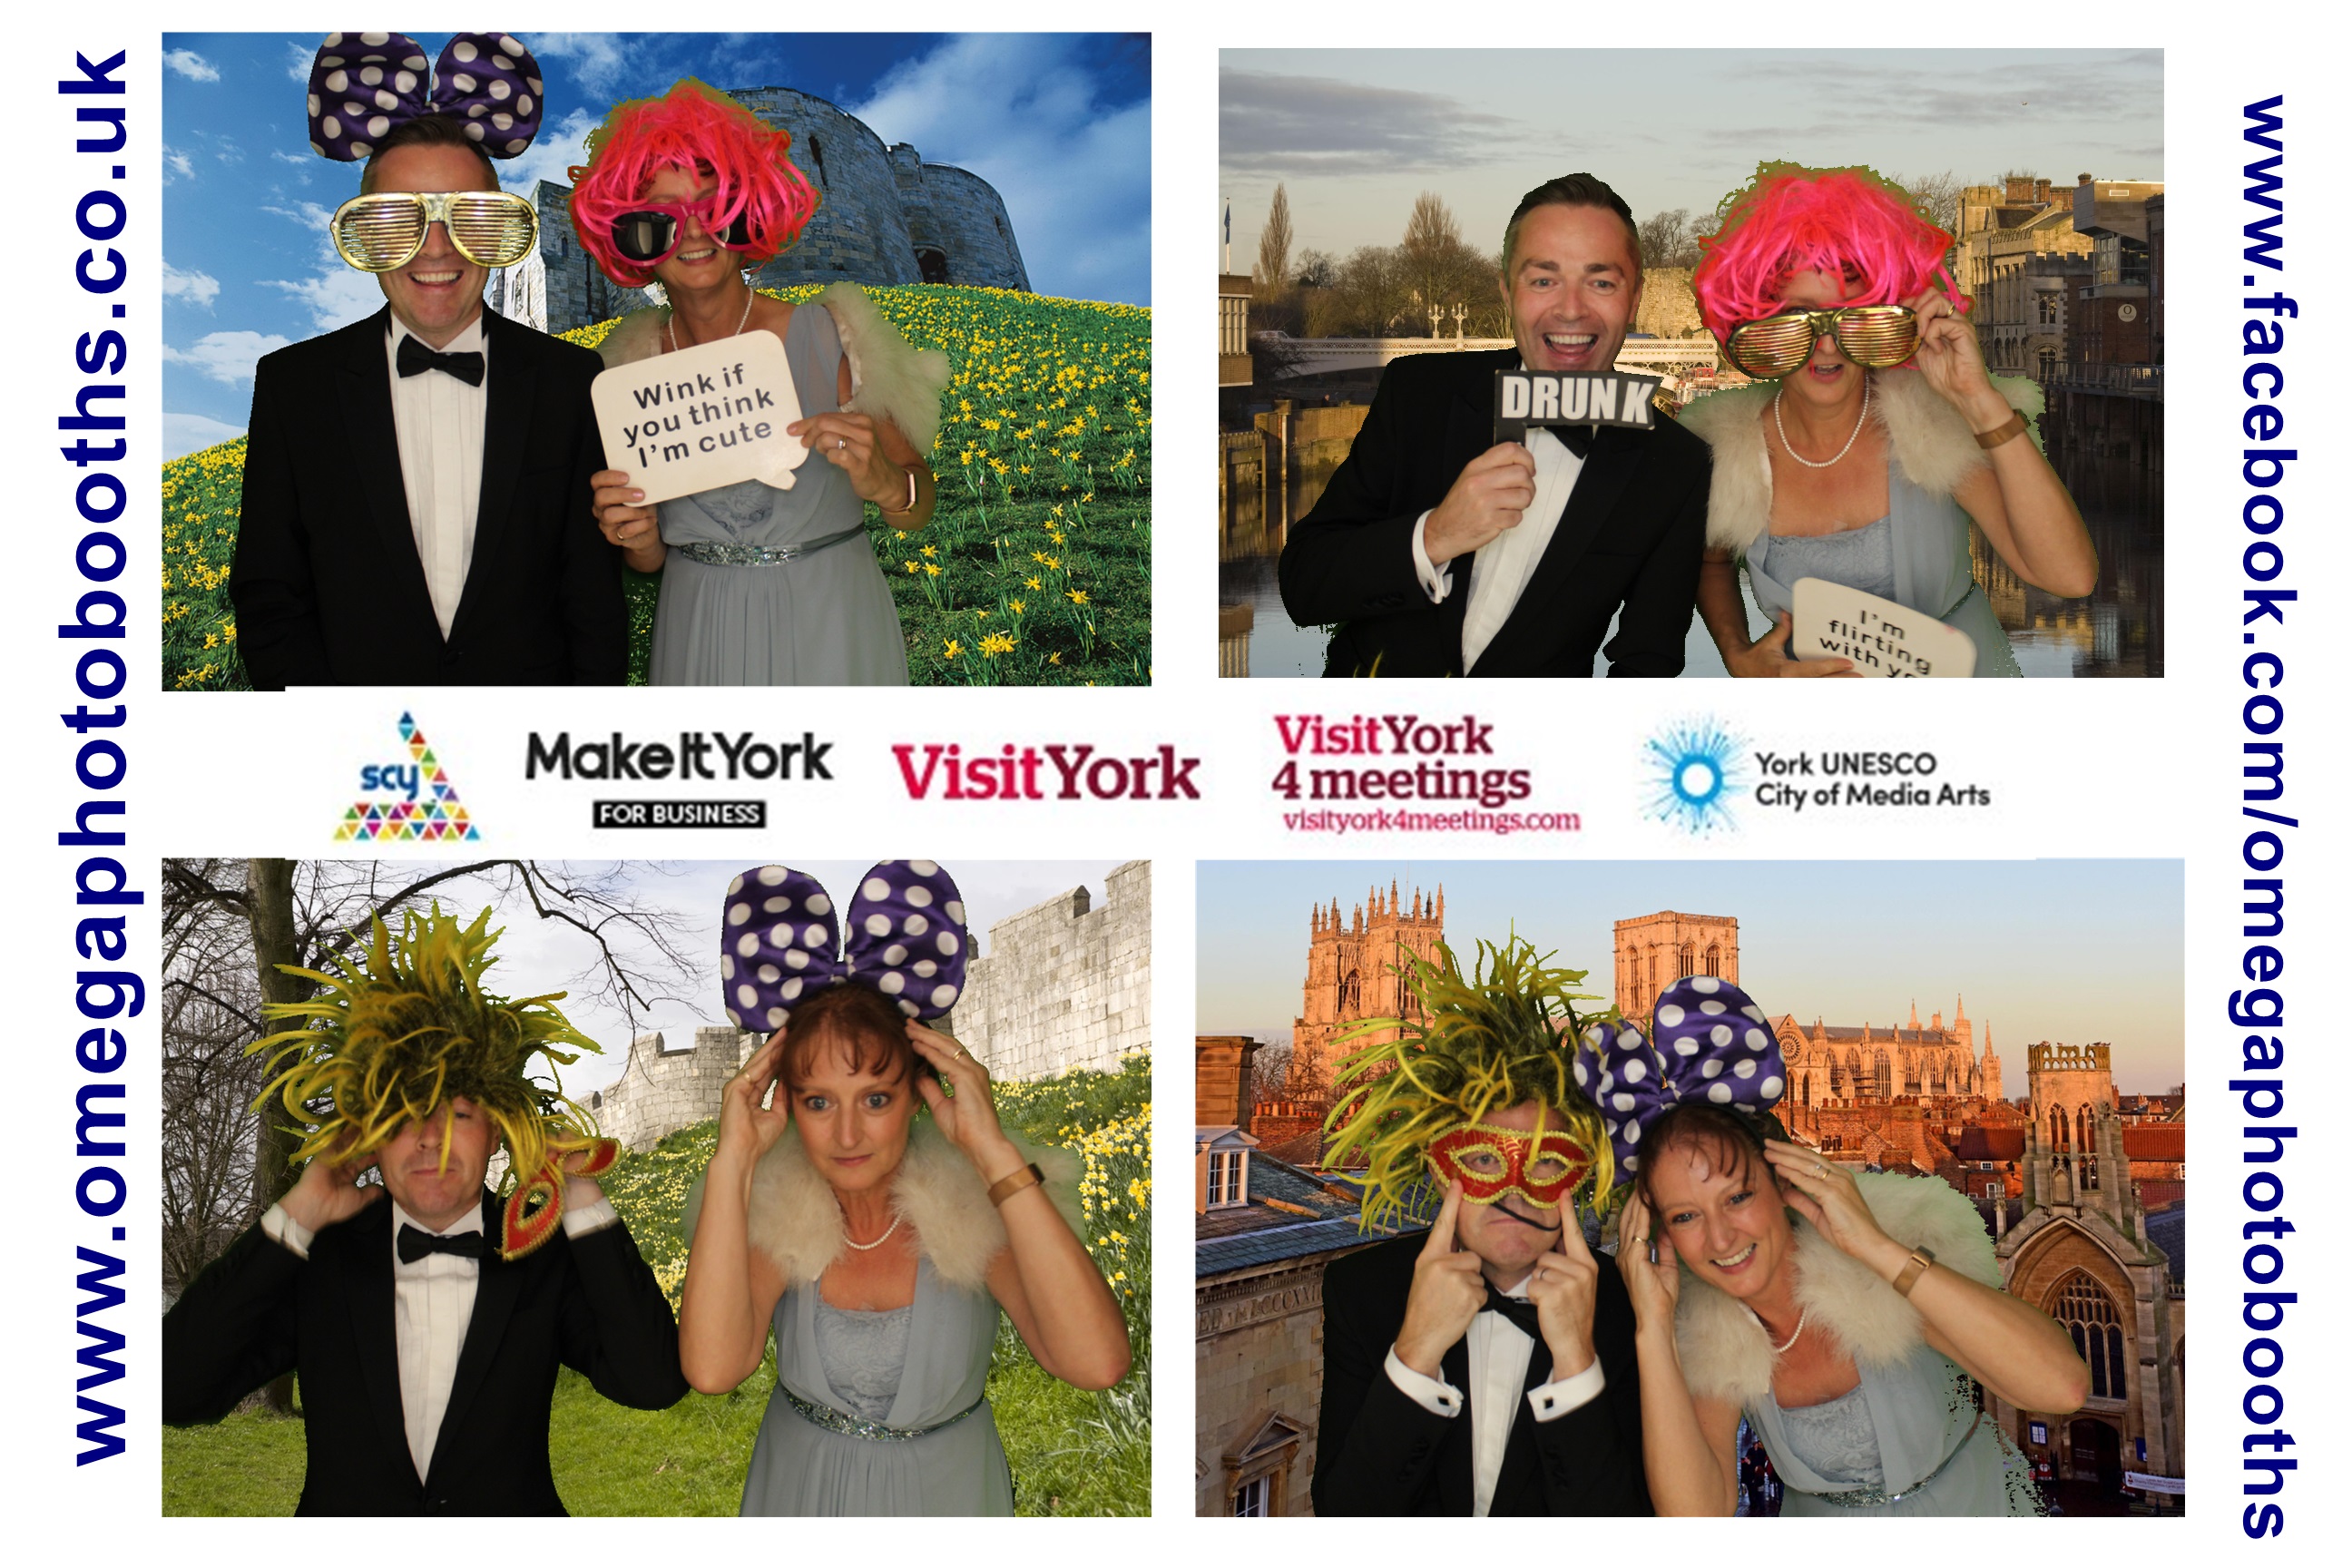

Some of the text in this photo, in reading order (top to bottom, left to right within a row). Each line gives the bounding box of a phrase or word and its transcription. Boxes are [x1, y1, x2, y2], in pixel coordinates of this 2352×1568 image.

[632, 362, 744, 409] Wink if
[1502, 375, 1655, 425] DRUNK
[622, 387, 775, 448] you think
[698, 420, 772, 453] cute
[1818, 636, 1880, 669] with
[1828, 619, 1933, 676] flirting
